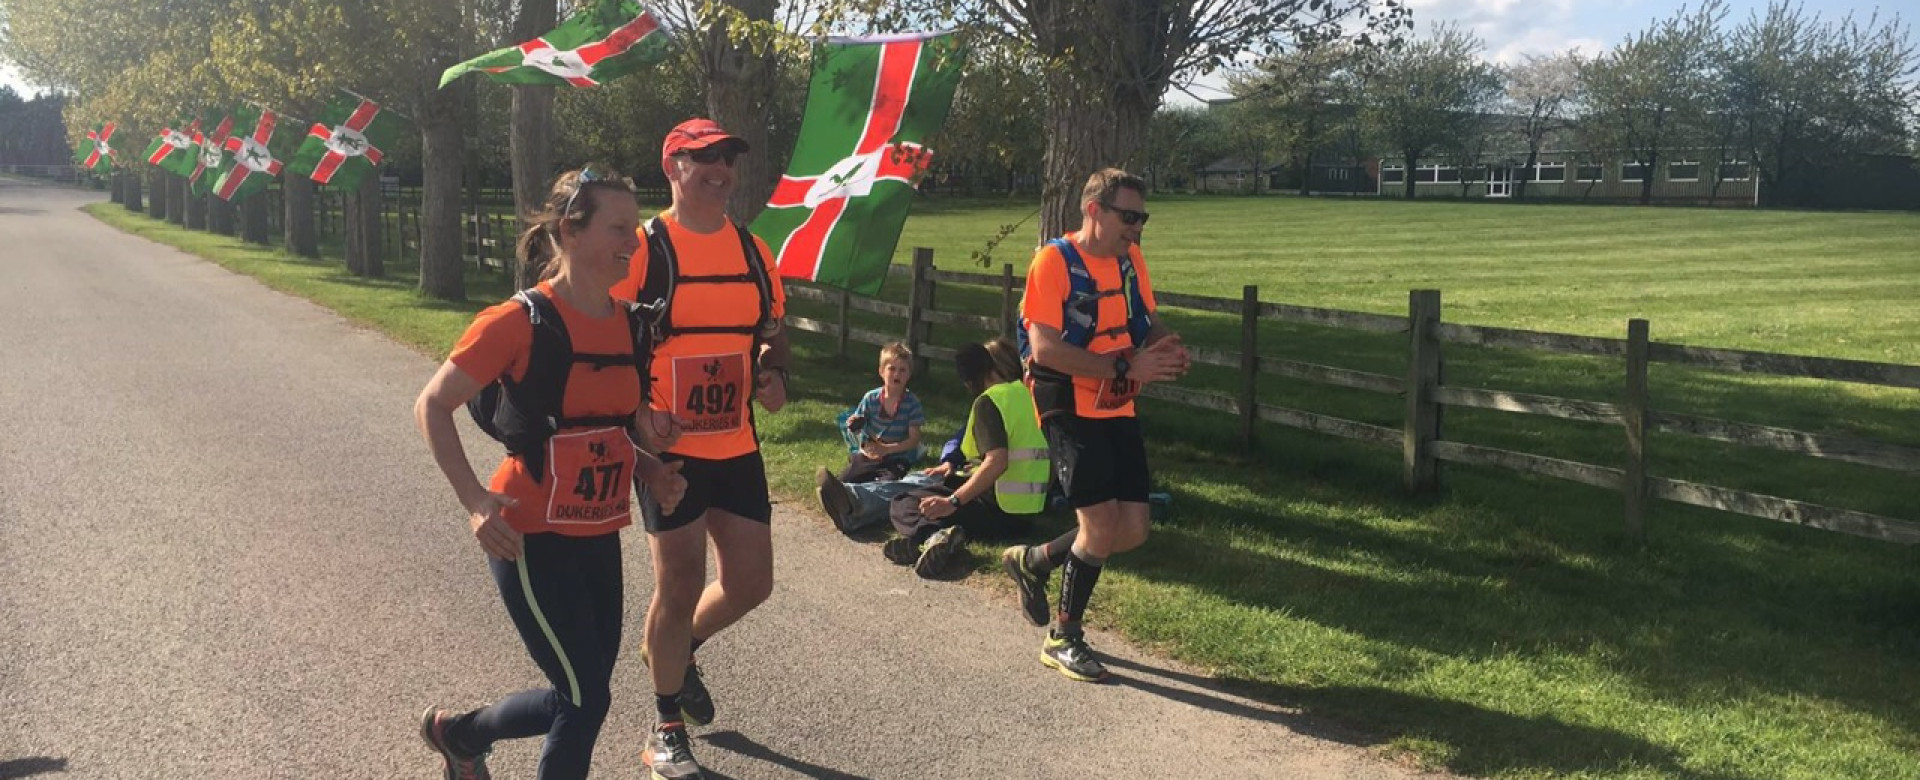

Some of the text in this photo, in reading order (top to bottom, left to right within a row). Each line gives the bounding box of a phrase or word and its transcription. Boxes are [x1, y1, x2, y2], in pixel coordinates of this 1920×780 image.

[686, 382, 736, 415] 492
[573, 461, 624, 501] 477
[556, 502, 613, 519] DUKERIES
